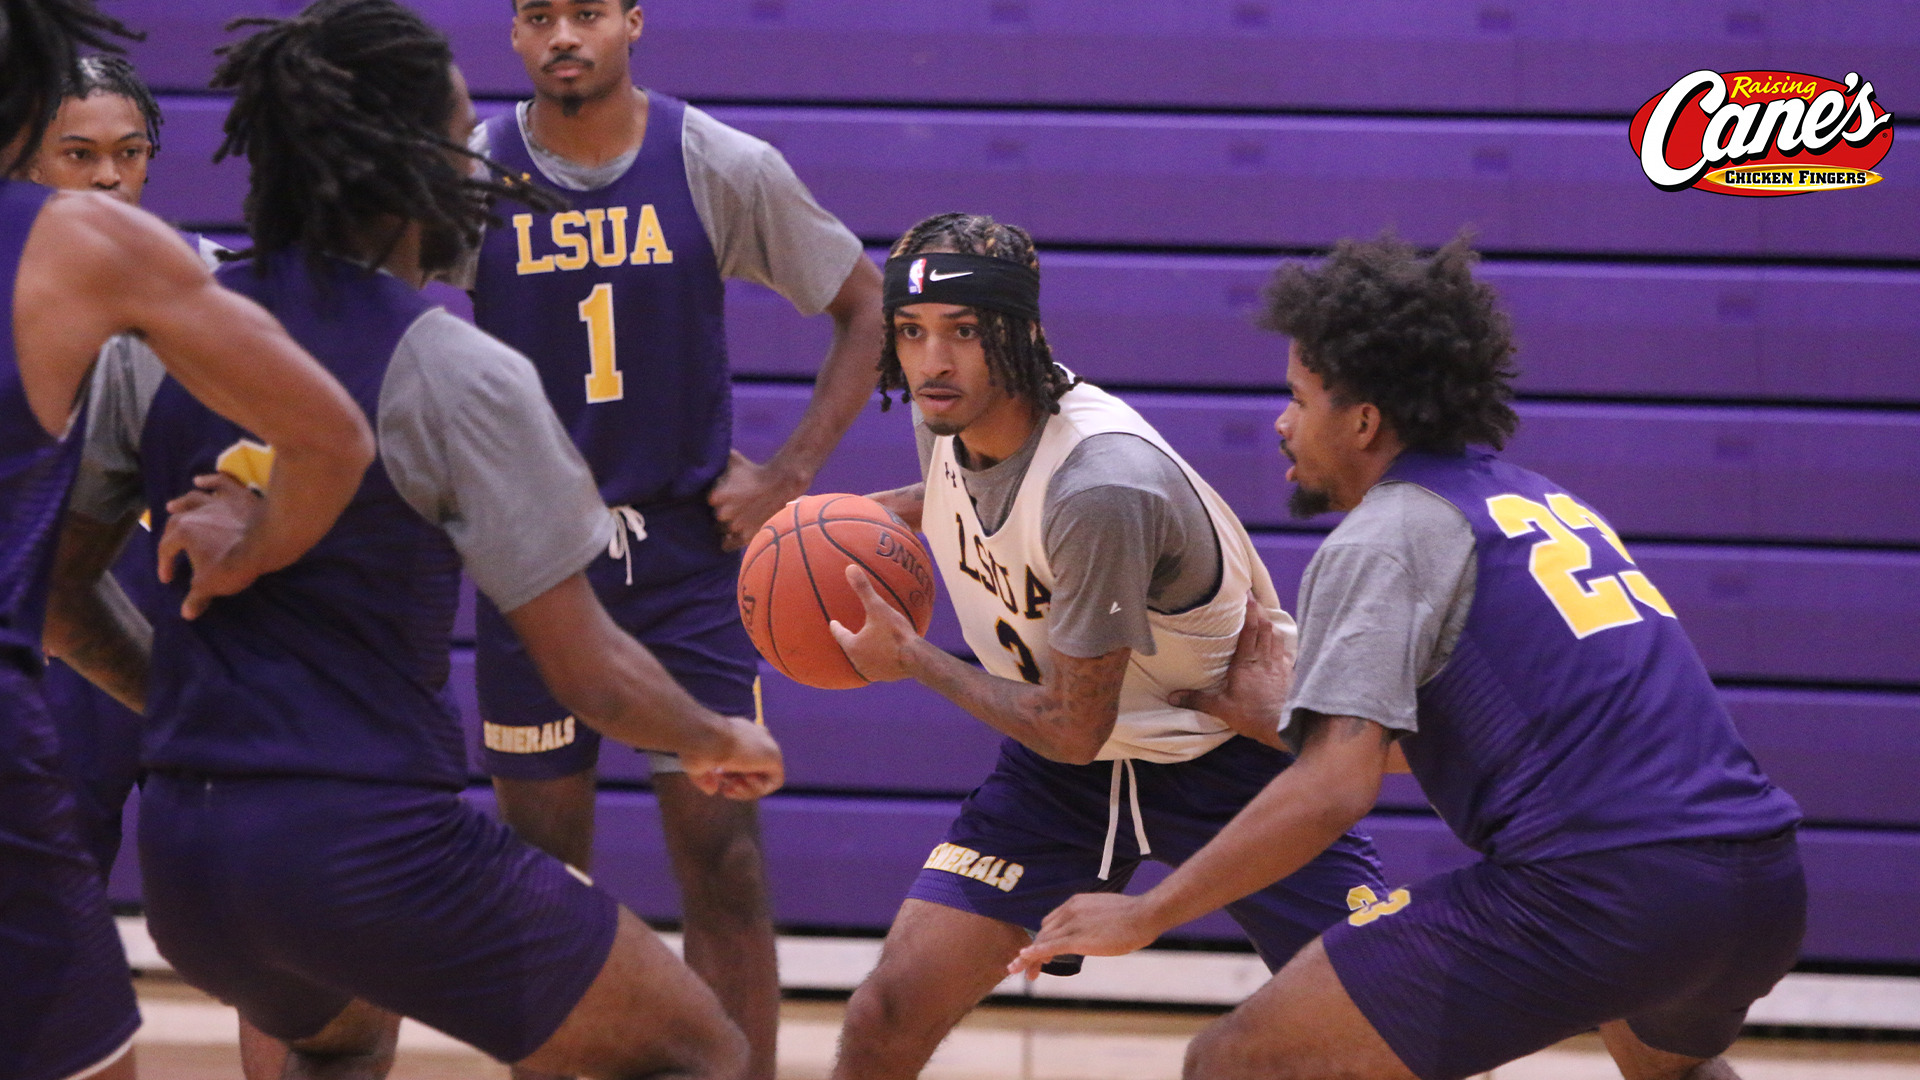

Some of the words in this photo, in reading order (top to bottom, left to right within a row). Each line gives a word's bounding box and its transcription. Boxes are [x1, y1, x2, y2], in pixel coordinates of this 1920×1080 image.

[512, 204, 673, 275] LSUA
[578, 282, 624, 404] 1
[956, 512, 1051, 620] LSUA
[922, 842, 1025, 893] ENERALS
